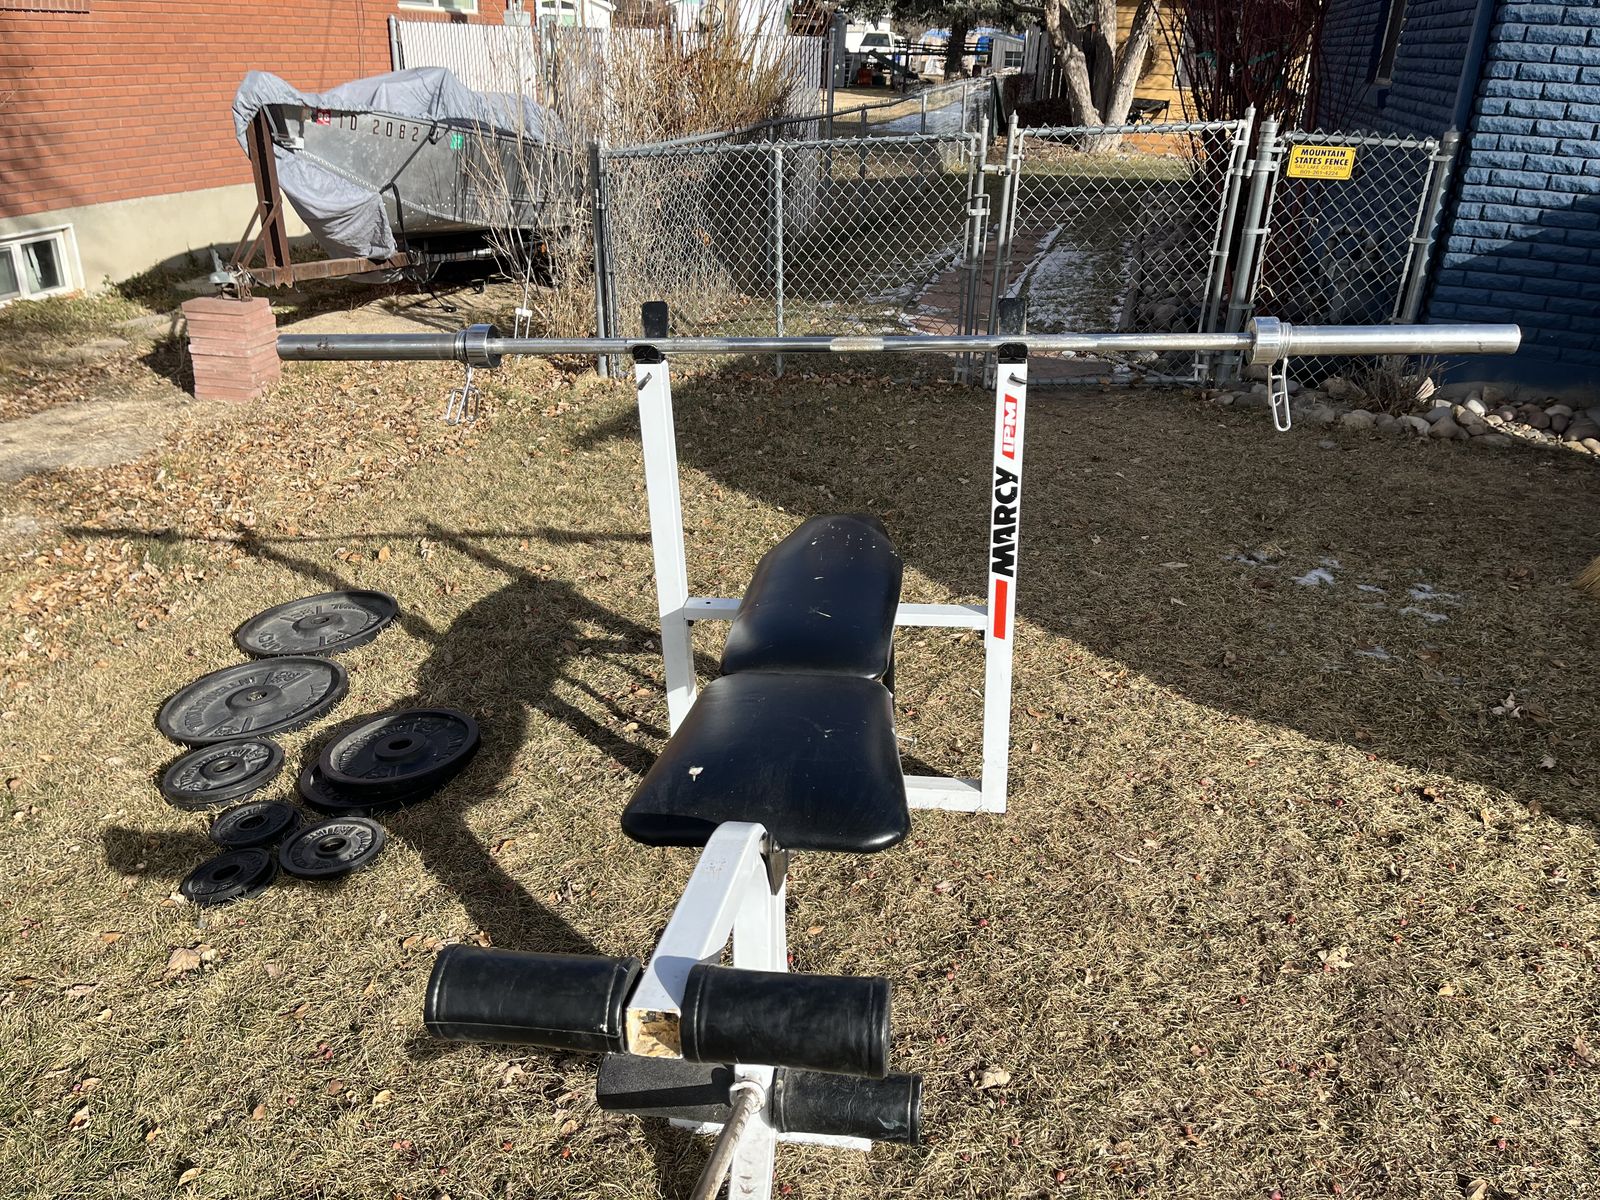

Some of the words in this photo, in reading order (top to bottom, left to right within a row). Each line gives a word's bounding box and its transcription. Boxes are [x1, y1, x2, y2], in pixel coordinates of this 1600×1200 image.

[339, 113, 358, 131] ID
[373, 119, 419, 142] 2082
[1295, 157, 1322, 165] STATES
[1325, 158, 1349, 166] FENCE
[1301, 149, 1346, 157] MOUNTAIN
[1002, 401, 1017, 453] IPM
[991, 465, 1019, 578] MARCY
